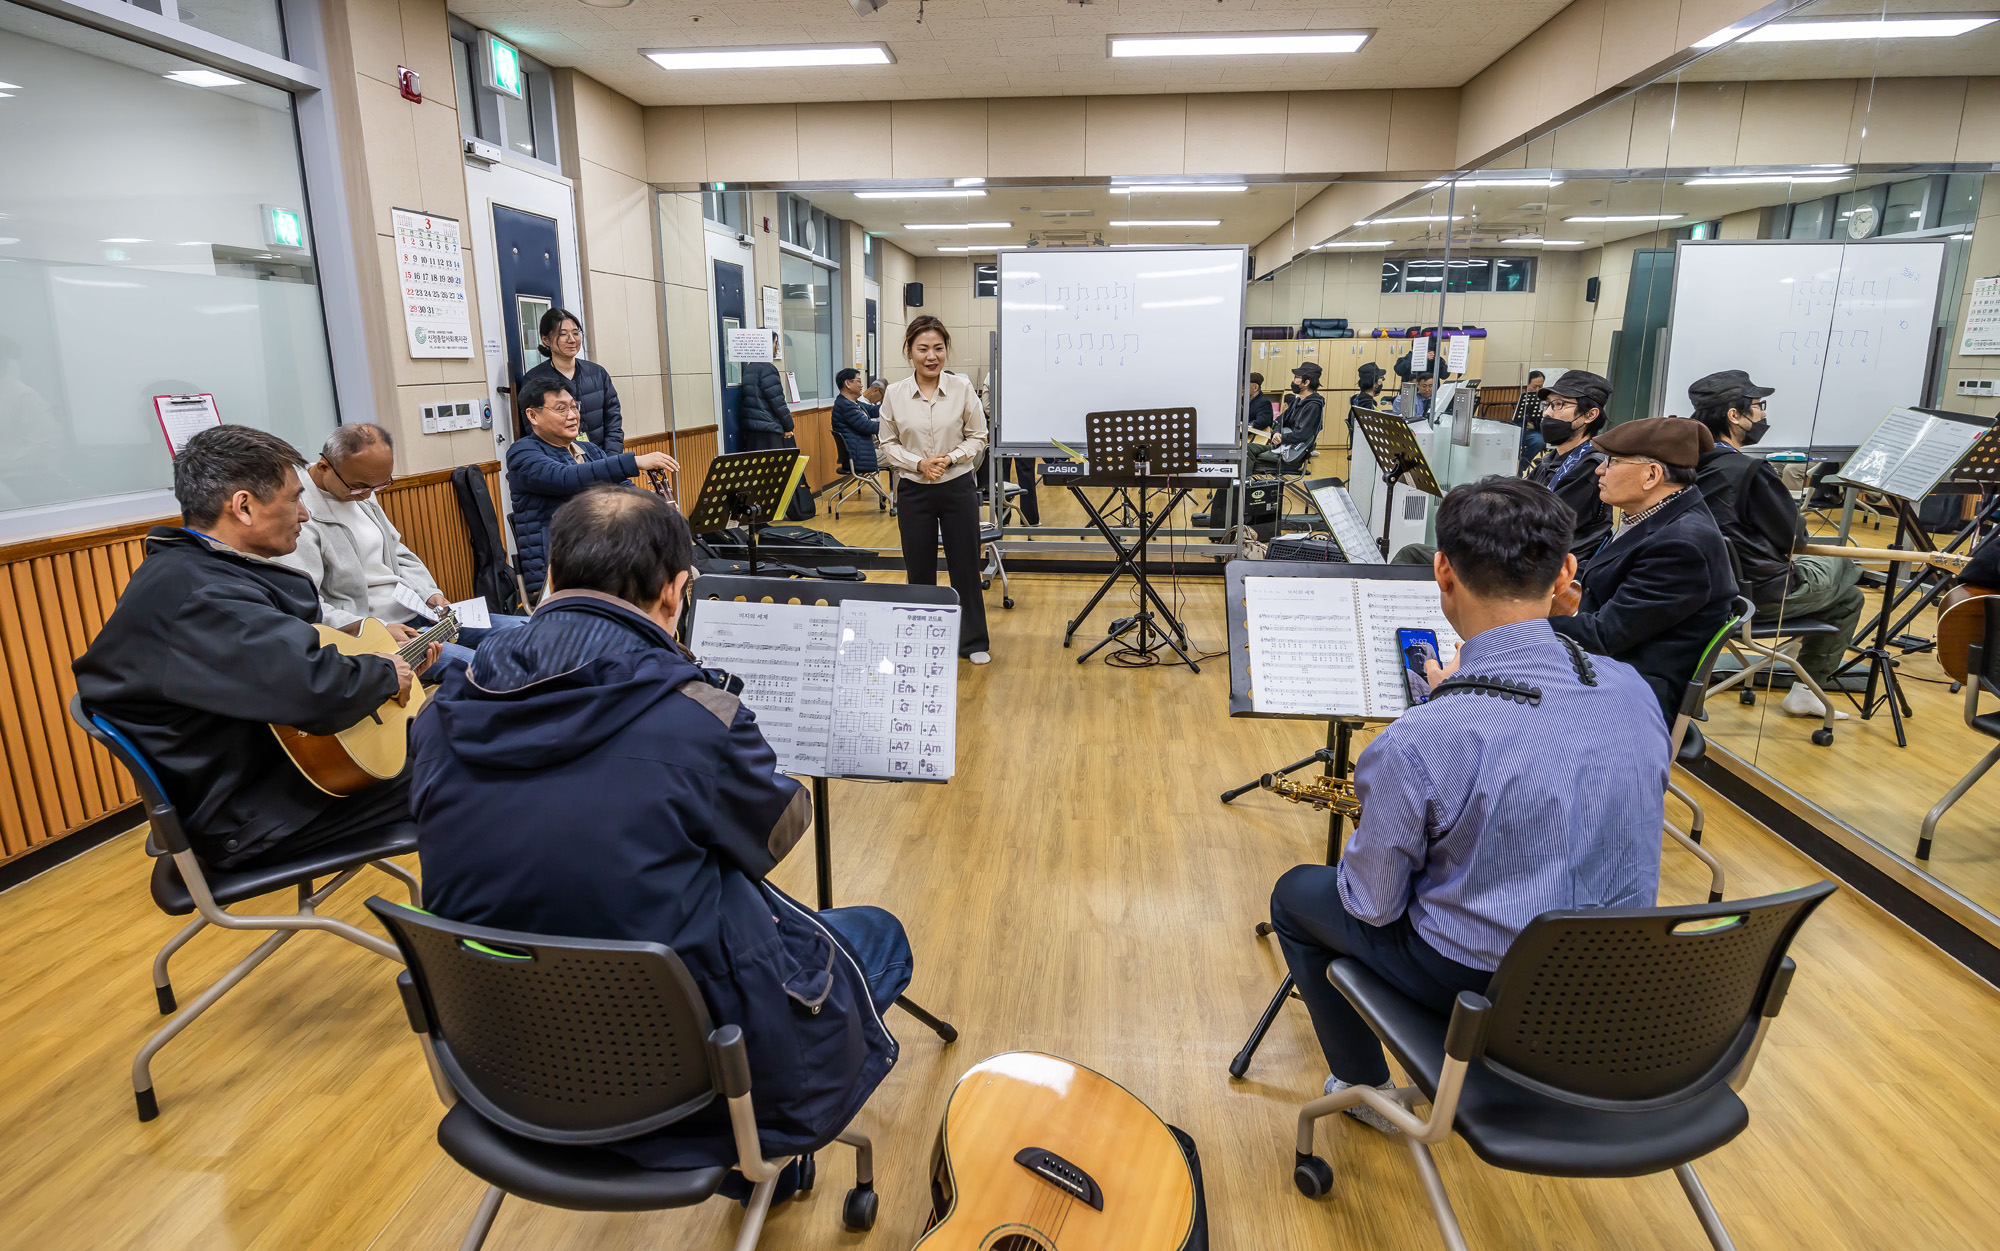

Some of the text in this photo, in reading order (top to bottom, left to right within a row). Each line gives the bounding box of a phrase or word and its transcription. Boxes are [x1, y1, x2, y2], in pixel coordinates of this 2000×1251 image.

[425, 218, 432, 230] 3
[453, 244, 457, 252] 7
[403, 253, 409, 262] 8
[412, 254, 417, 262] 9
[420, 256, 428, 264] 10
[429, 257, 436, 265] 11
[437, 258, 445, 266] 12
[405, 271, 412, 279] 15
[413, 272, 421, 280] 16
[422, 273, 429, 281] 17
[431, 273, 438, 282] 18
[447, 275, 454, 283] 20
[455, 276, 461, 284] 21
[406, 288, 415, 296] 22
[415, 288, 423, 297] 23
[423, 289, 432, 297] 24
[432, 290, 440, 298] 25
[440, 291, 449, 299] 26
[409, 304, 435, 314] 29 30 31
[905, 627, 946, 638] C C7
[904, 645, 946, 656] D D7
[898, 664, 944, 676] Dm E7
[898, 683, 939, 694] Em F
[900, 702, 942, 714] G G7
[894, 722, 938, 733] Gm A
[895, 741, 941, 753] A7 Am
[895, 761, 908, 771] B7
